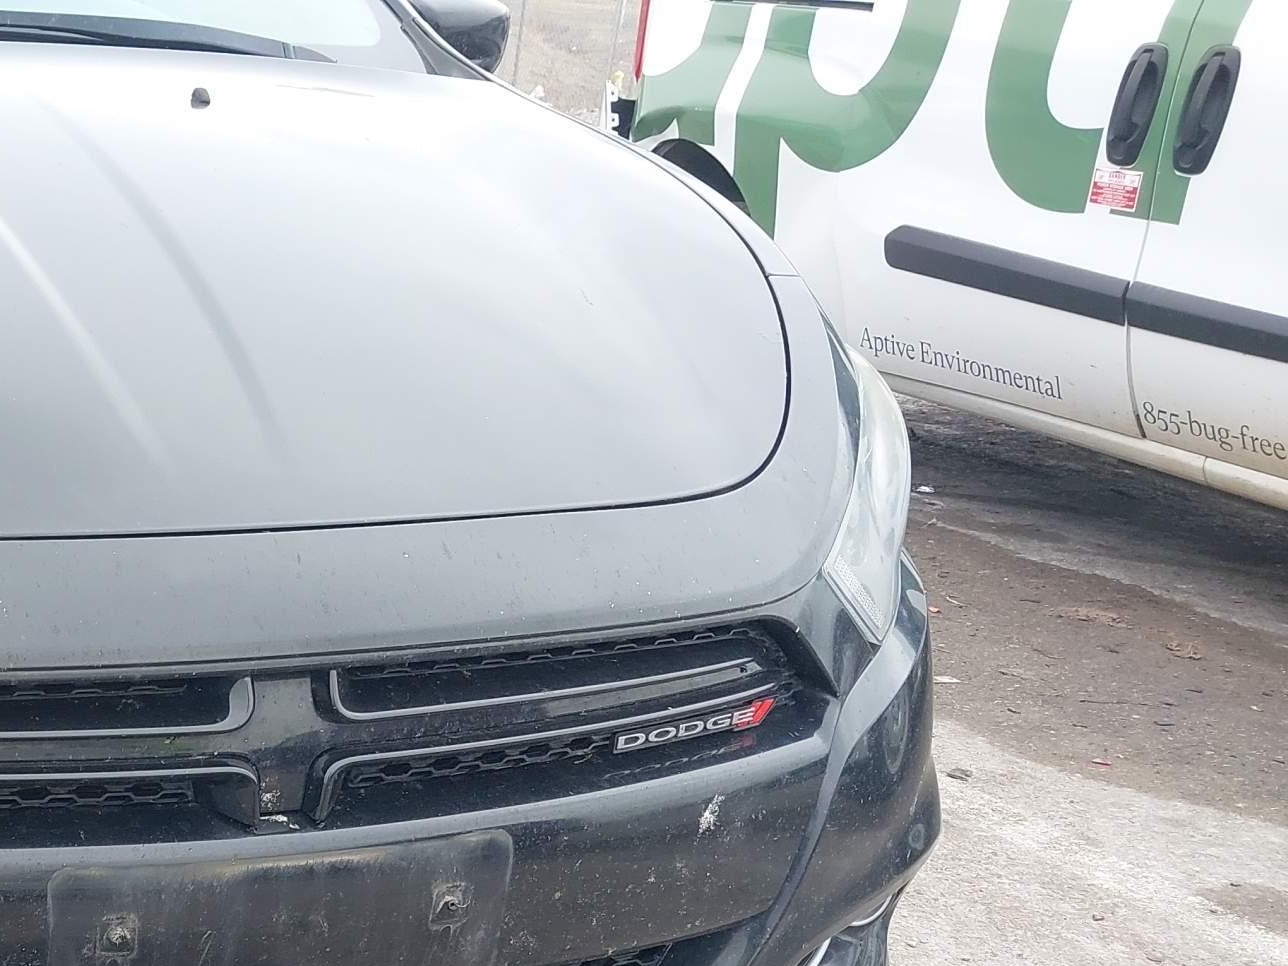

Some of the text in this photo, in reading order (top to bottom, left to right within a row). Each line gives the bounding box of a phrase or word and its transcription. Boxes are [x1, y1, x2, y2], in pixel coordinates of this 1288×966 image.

[859, 326, 1063, 400] Aptive Environmental
[1142, 400, 1288, 461] 855-bug-free
[615, 706, 756, 751] DODGE
